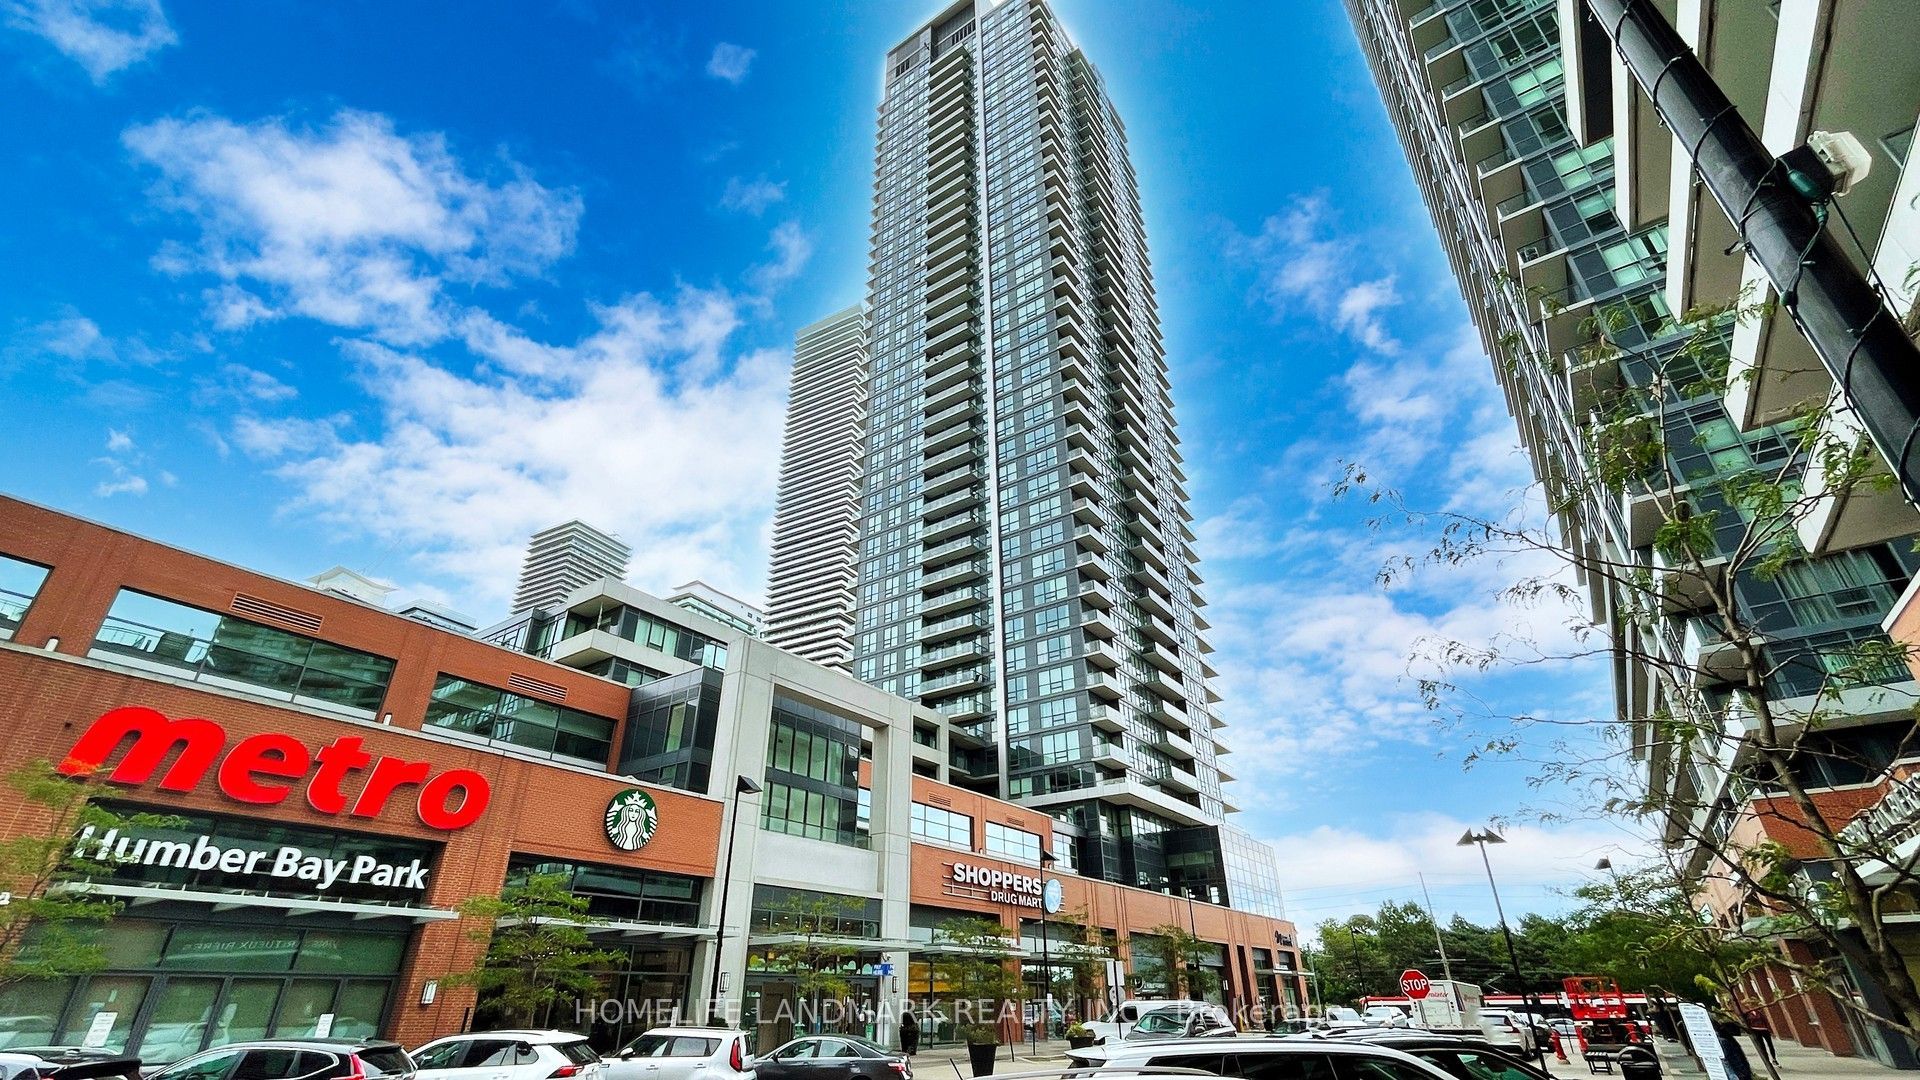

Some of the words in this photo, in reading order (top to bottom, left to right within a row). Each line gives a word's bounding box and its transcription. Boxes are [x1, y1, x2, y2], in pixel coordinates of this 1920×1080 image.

[55, 706, 491, 830] metro
[71, 825, 267, 875] Humber
[271, 846, 349, 890] Bay
[350, 855, 430, 890] Park
[953, 862, 1042, 896] SHOPPERS
[990, 890, 1018, 905] DRUG
[1018, 894, 1042, 909] MART
[1402, 978, 1427, 992] STOP
